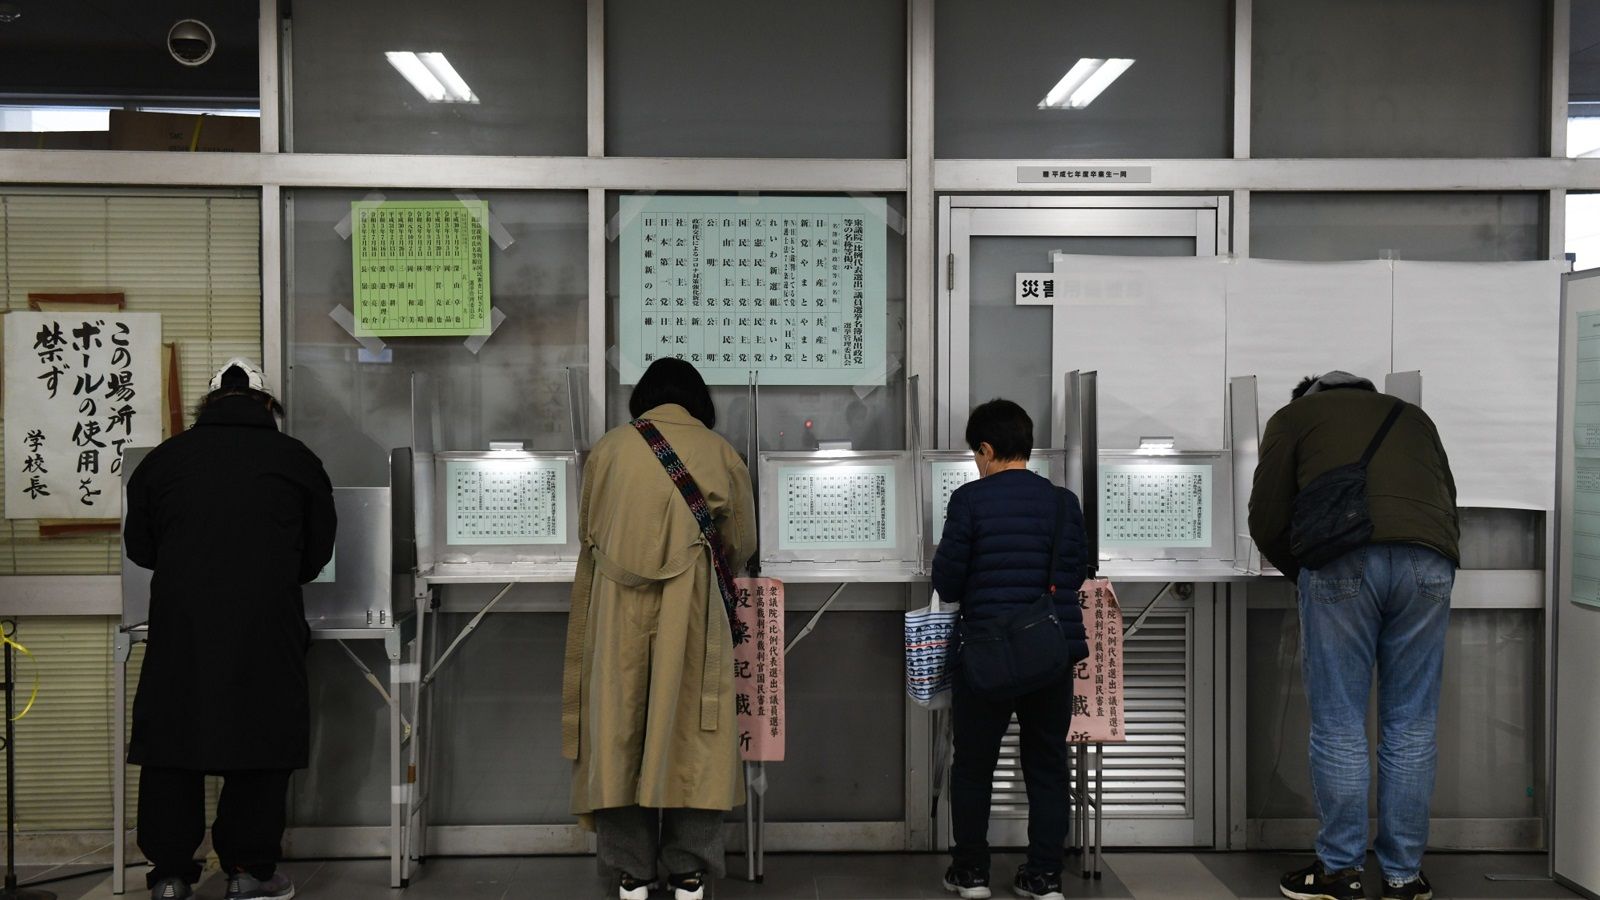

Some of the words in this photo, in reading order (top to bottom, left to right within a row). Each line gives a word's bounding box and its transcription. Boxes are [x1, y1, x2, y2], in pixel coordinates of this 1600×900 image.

[645, 219, 653, 306] 日本維新の会
[660, 219, 669, 306] 日本第一党
[675, 219, 684, 306] 社会民主党
[707, 219, 715, 306] 公明党
[722, 219, 731, 306] 自由民主党
[738, 219, 747, 306] 国民民主党
[754, 219, 762, 307] 立憲民主党
[770, 219, 778, 307] れいわ新選組
[801, 219, 809, 306] 新党やまと
[816, 219, 824, 307] 日本共産党
[33, 321, 70, 400] 禁ず
[645, 318, 653, 362] 維新
[675, 318, 684, 361] 社民党
[691, 318, 699, 362] 新党
[707, 318, 715, 362] 公明
[722, 318, 731, 362] 自民党
[738, 318, 747, 362] 民主党
[754, 318, 762, 362] 民主党
[770, 318, 778, 362] れいわ
[784, 318, 792, 362] NHK党
[801, 318, 809, 361] やまと
[816, 318, 824, 362] 共産党
[843, 322, 852, 366] 選挙管理委員会
[72, 319, 107, 506] ボールの使用を
[22, 429, 51, 500] 学校長
[756, 586, 765, 716] 最高裁判所裁判官国民審査
[1095, 588, 1104, 717] 最高裁判所裁判官国民審査
[1107, 597, 1118, 736] 議院（比例代表選出）議員選挙
